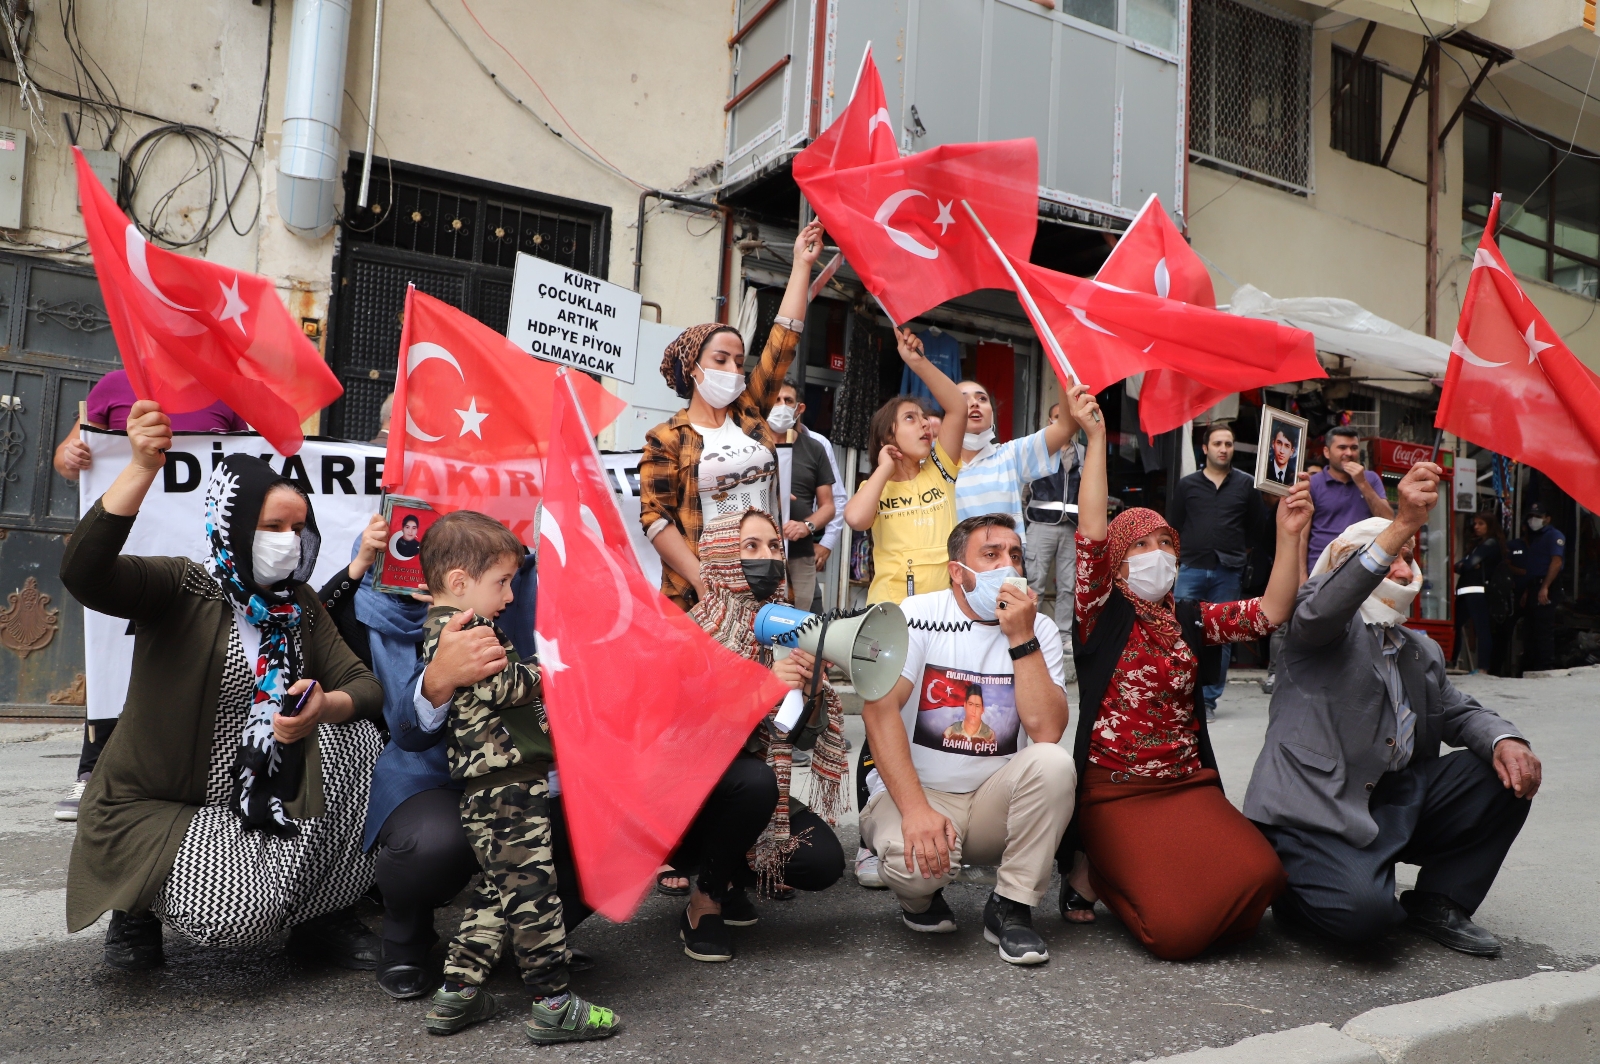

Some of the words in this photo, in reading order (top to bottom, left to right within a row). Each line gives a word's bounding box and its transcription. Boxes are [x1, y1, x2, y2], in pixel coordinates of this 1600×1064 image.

[564, 272, 601, 294] KÜRT
[538, 283, 616, 319] ÇOCUKLARI
[557, 309, 599, 332] ARTIK
[531, 340, 614, 374] OLMAYACAK
[582, 334, 621, 358] PİYON
[879, 496, 912, 511] NEW
[942, 738, 972, 750] RAHİM
[974, 741, 998, 754] ÇİFÇİ
